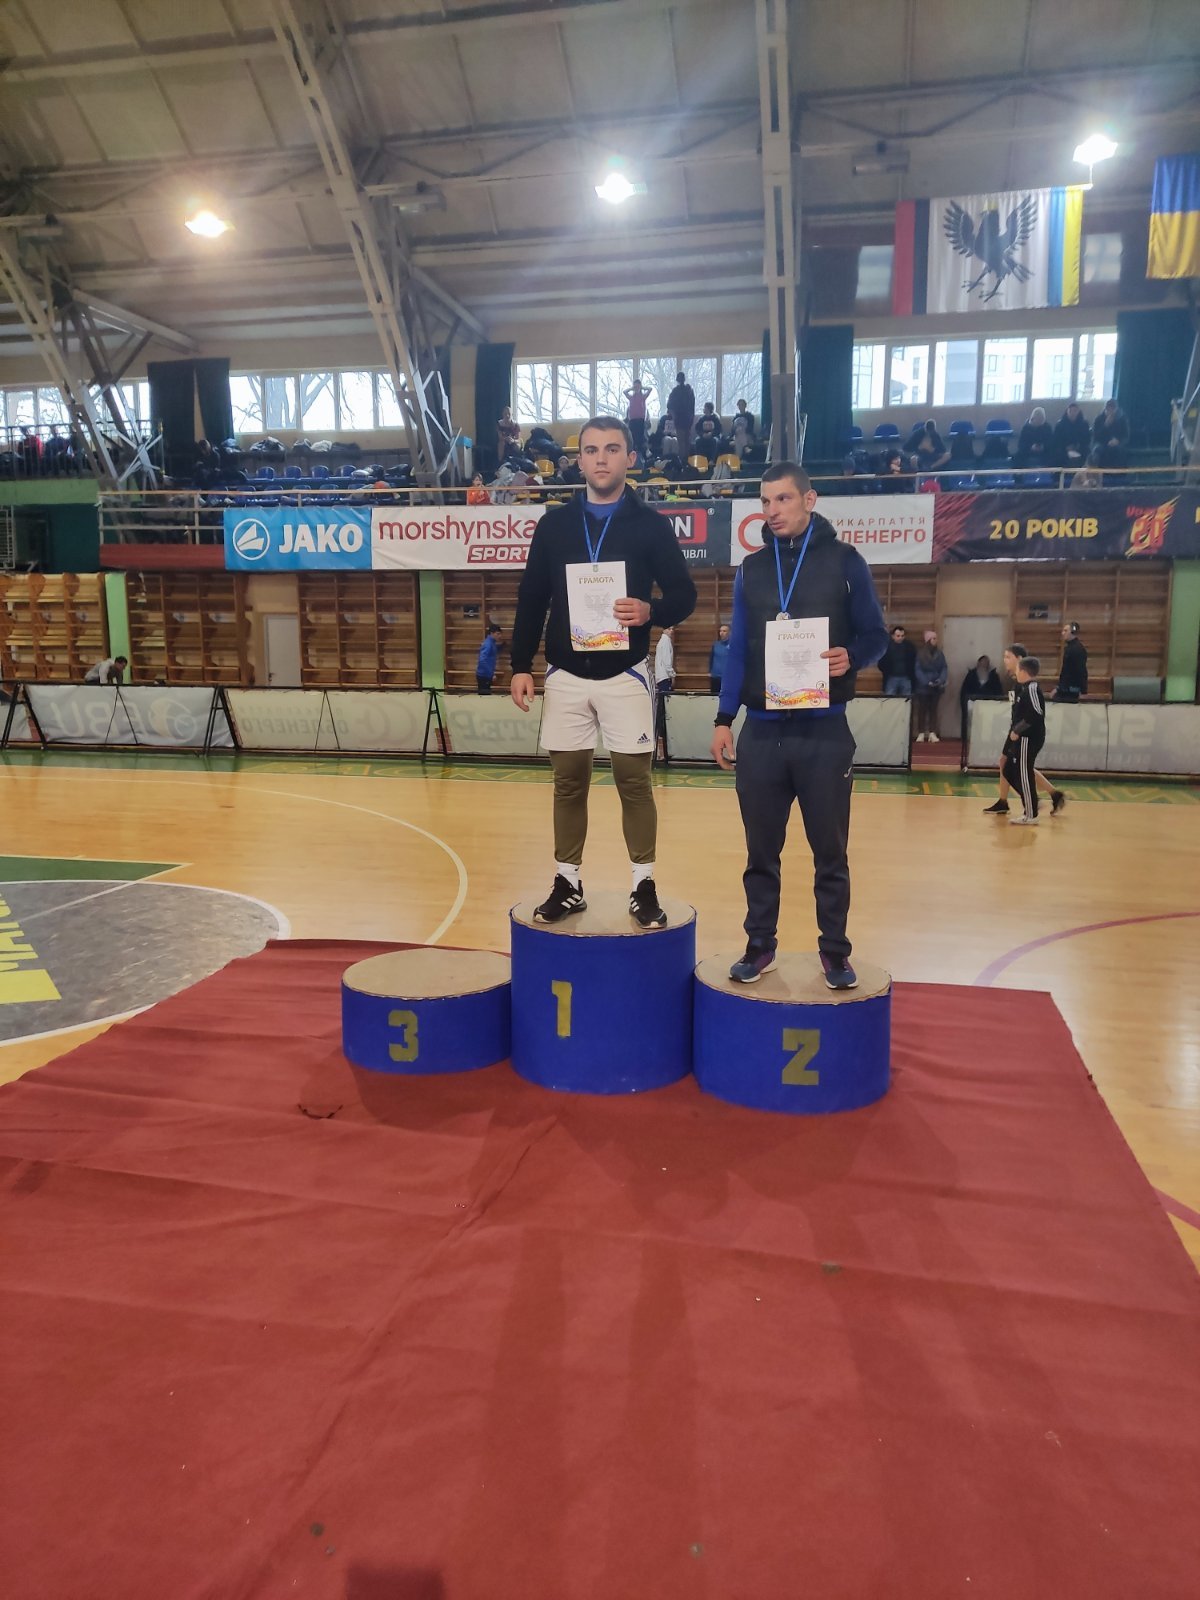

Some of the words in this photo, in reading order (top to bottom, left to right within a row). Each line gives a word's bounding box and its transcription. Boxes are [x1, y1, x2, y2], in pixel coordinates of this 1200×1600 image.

[379, 514, 537, 545] morshynska
[829, 517, 926, 527] ИКАРПАТТЯ
[989, 519, 1020, 540] 20
[1026, 517, 1099, 539] РОКІВ
[278, 523, 364, 554] JAKO
[841, 528, 927, 544] ЛЕНЕРГО
[578, 576, 615, 585] ГРАМОТА
[777, 632, 816, 641] ГРАМОТА
[551, 980, 573, 1038] 1
[388, 1009, 420, 1063] 3
[781, 1027, 821, 1086] 2
